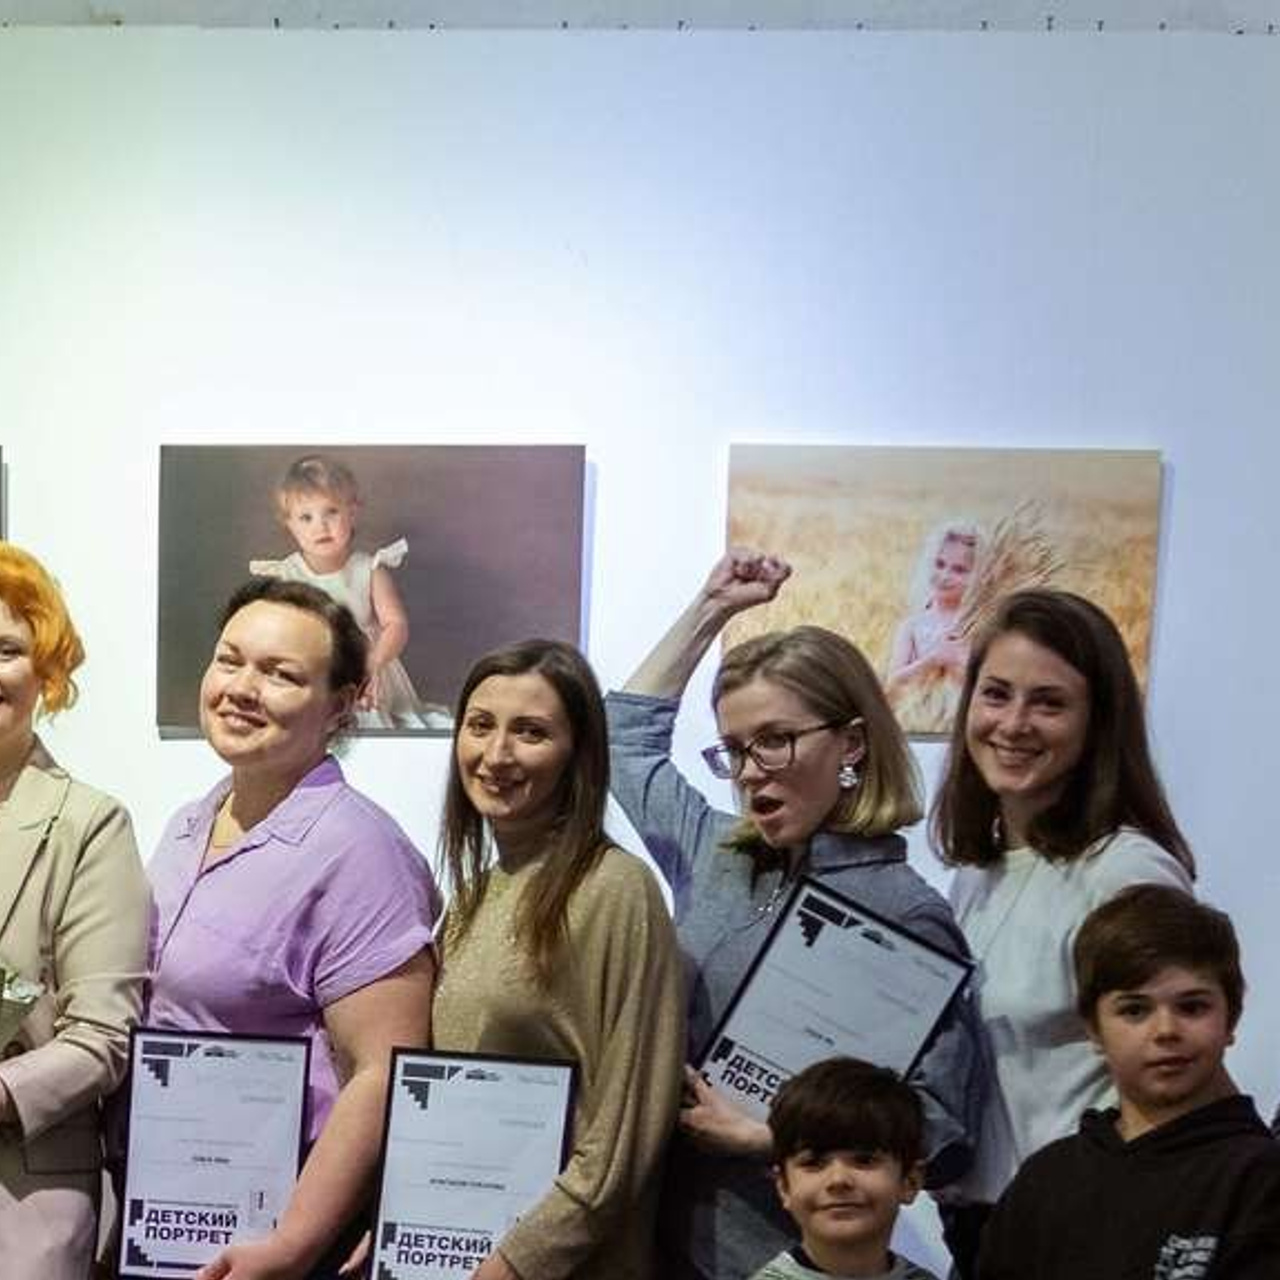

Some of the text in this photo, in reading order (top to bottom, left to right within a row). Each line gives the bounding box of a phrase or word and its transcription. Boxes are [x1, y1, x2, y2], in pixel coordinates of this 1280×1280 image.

[727, 1054, 781, 1088] ДЕТС
[721, 1069, 774, 1102] ПОРТ
[145, 1209, 238, 1229] ДЕТСКИЙ
[145, 1226, 233, 1245] ПОРТРЕТ
[398, 1233, 493, 1254] ДЕТСКИЙ
